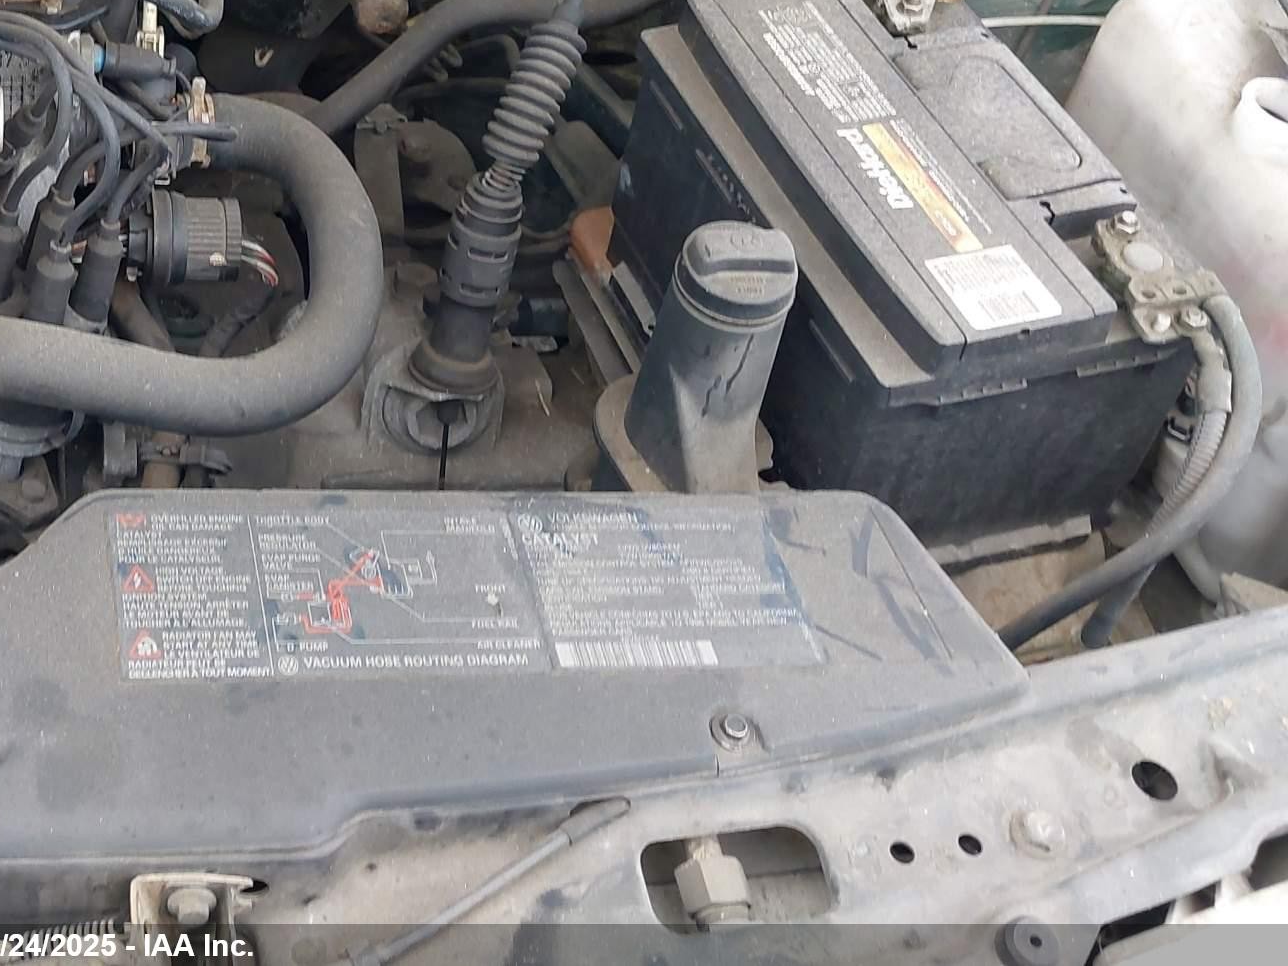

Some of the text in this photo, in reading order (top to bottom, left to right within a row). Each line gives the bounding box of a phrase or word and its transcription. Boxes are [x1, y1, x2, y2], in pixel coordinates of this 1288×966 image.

[836, 128, 914, 209] DieHard
[304, 516, 329, 524] BODY
[549, 513, 639, 523] VOLKSWAGEN
[192, 522, 232, 531] DAMAGE
[522, 533, 599, 545] CATALYST
[262, 554, 321, 562] EVAP PURGE
[263, 562, 292, 570] VALVE
[475, 585, 506, 594] FRONT
[472, 619, 494, 628] FUEL
[214, 632, 234, 641] FAN
[235, 632, 257, 641] MAY
[163, 641, 194, 650] START
[211, 641, 233, 650] ANY
[235, 641, 259, 650] TIME
[300, 642, 329, 652] PUMP
[497, 639, 541, 650] CLEANER
[303, 657, 362, 669] VACUUM
[365, 656, 400, 668] HOSE
[404, 655, 464, 667] ROUTING
[467, 654, 529, 666] DIAGRAM
[201, 668, 226, 679] TOUT
